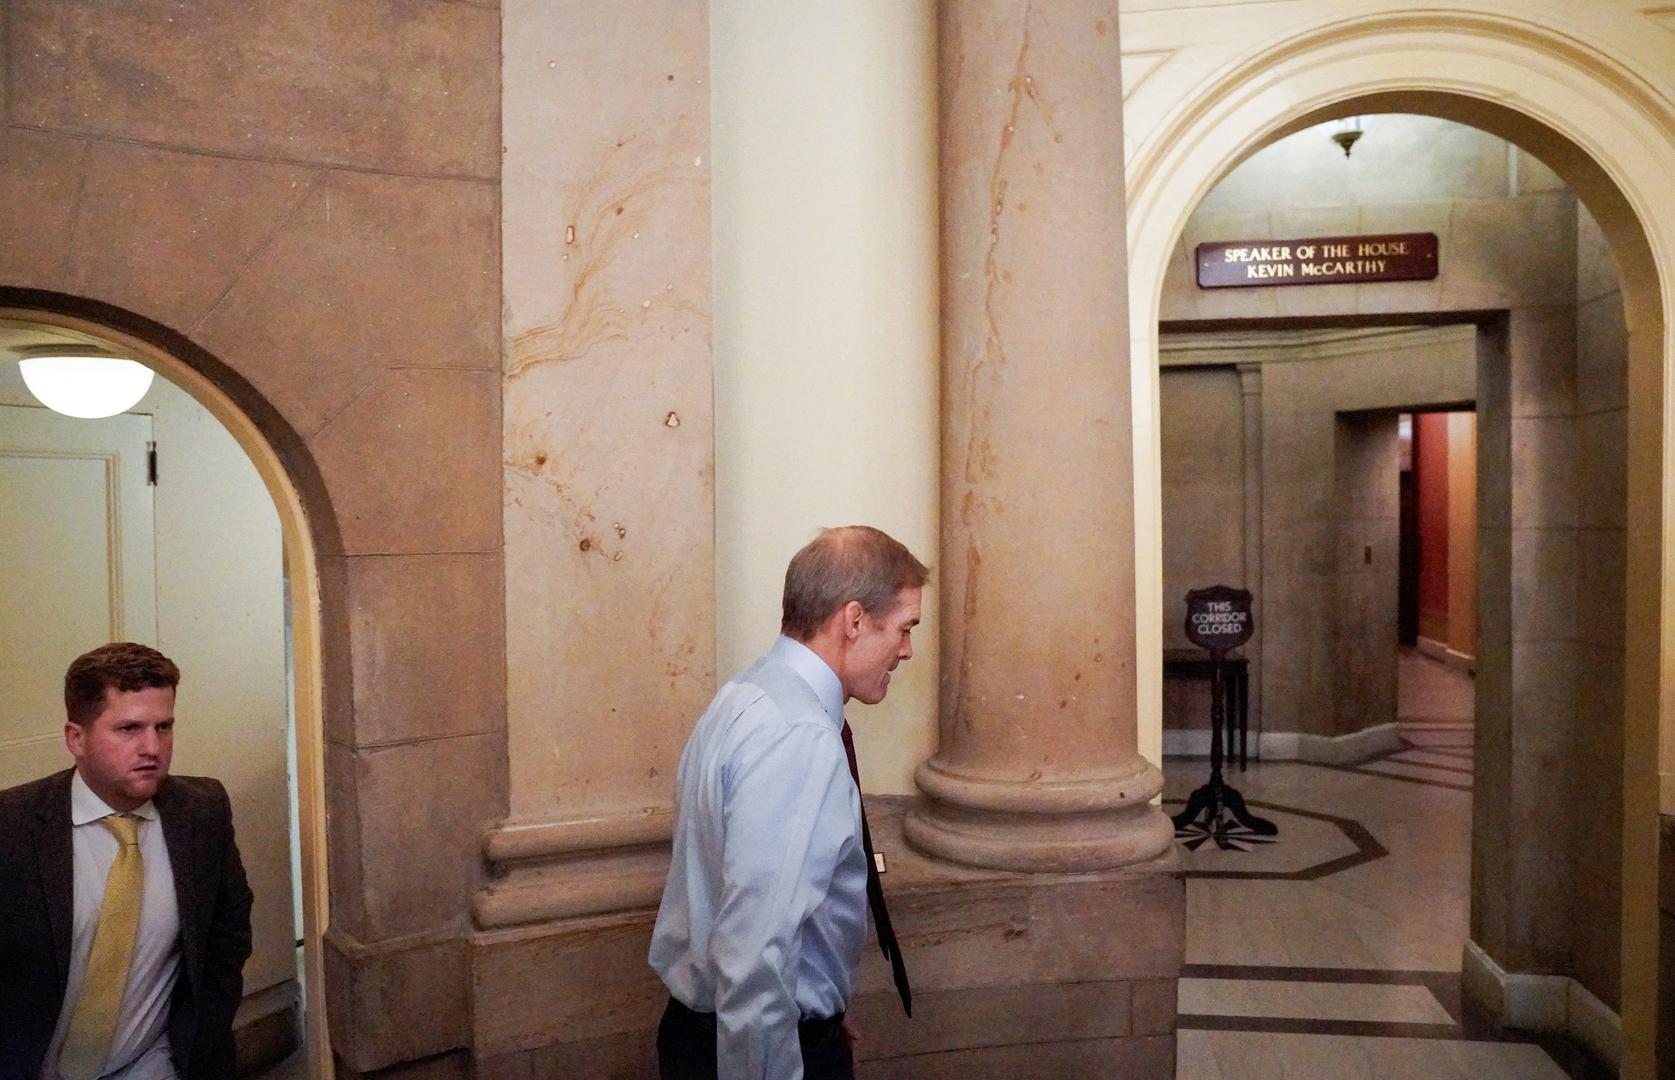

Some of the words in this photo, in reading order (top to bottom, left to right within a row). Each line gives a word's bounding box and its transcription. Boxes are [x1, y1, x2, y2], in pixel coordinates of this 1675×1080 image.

[1224, 247, 1292, 263] SPEAKER
[1296, 245, 1316, 260] OF
[1321, 244, 1350, 259] THE
[1358, 242, 1408, 257] HOUSE
[1247, 263, 1294, 279] KEVIN
[1301, 260, 1387, 277] McCARTHY
[1207, 601, 1231, 612] THIS
[1192, 612, 1246, 624] CORRIDOR
[1198, 623, 1242, 635] CLOSED
